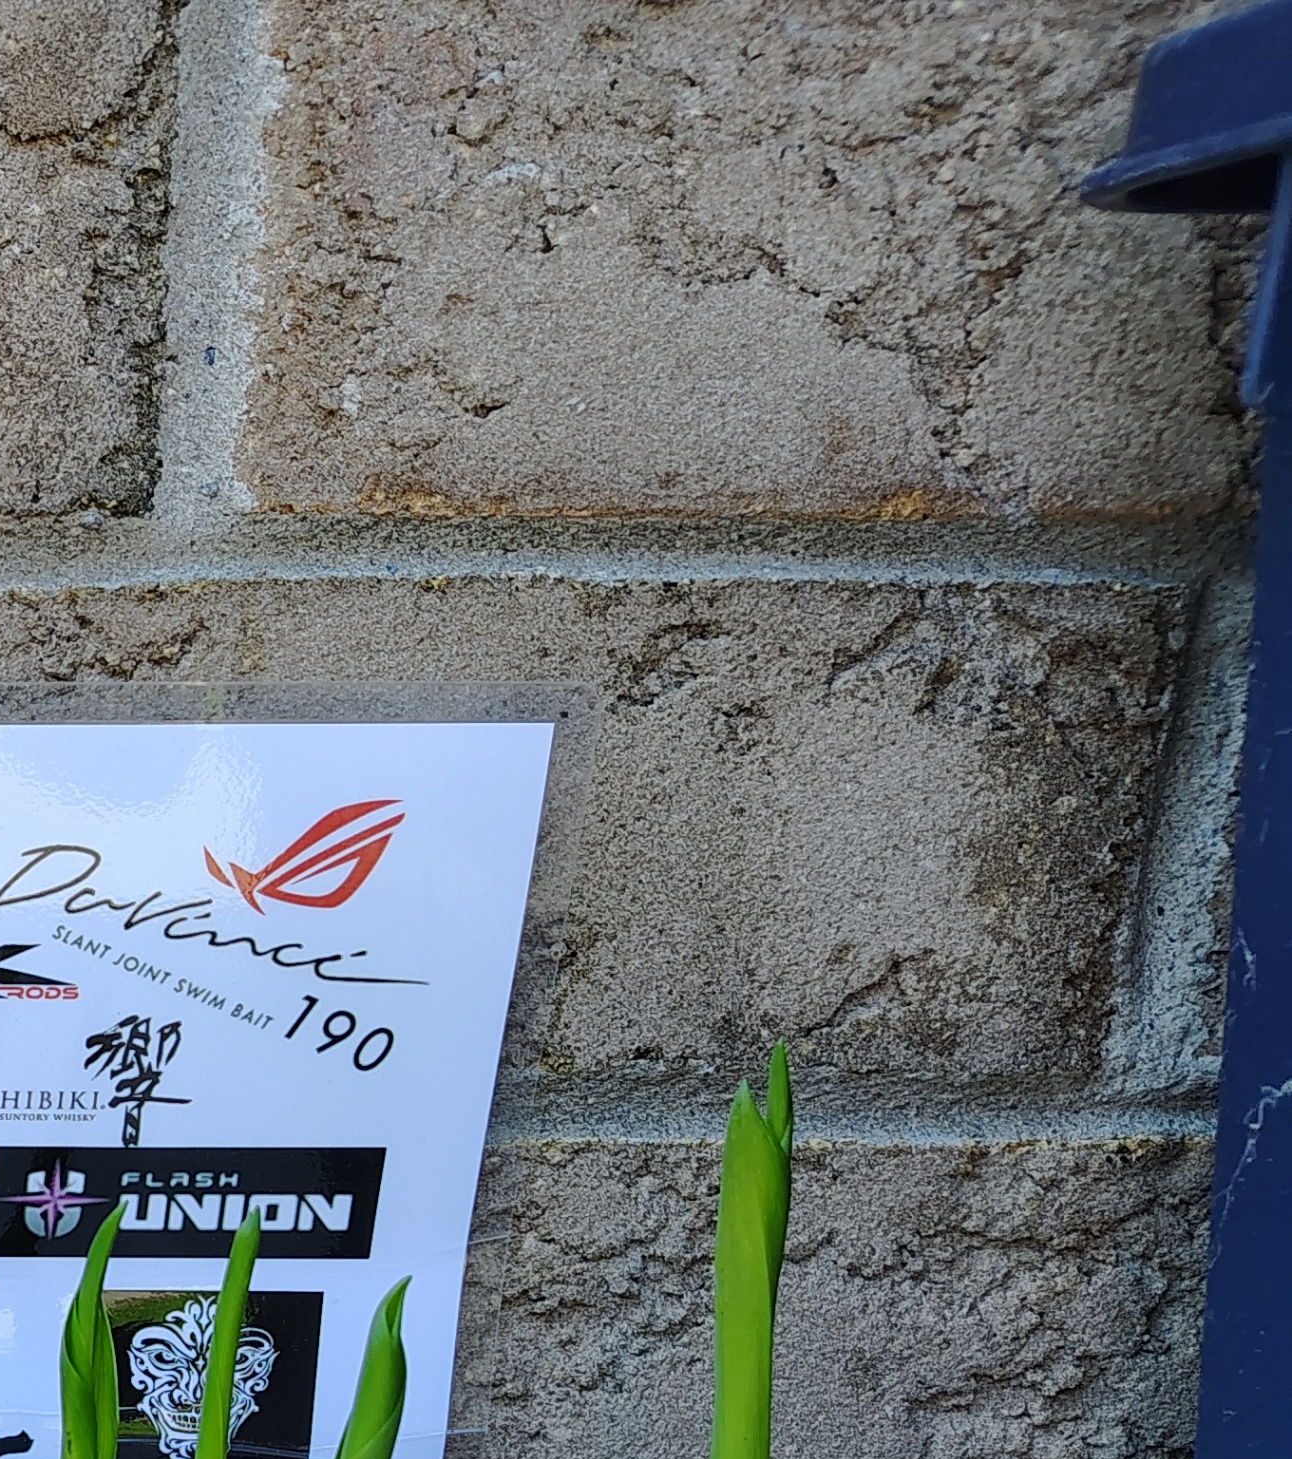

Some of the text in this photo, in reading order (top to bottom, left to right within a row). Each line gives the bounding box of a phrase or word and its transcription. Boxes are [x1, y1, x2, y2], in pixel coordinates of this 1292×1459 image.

[52, 924, 274, 1031] SLANT JOINT SWIM BAIT
[284, 994, 394, 1071] 190
[0, 1112, 97, 1122] SUNTORY WHISKY
[121, 1172, 239, 1188] FLASH
[119, 1194, 354, 1232] UNION
